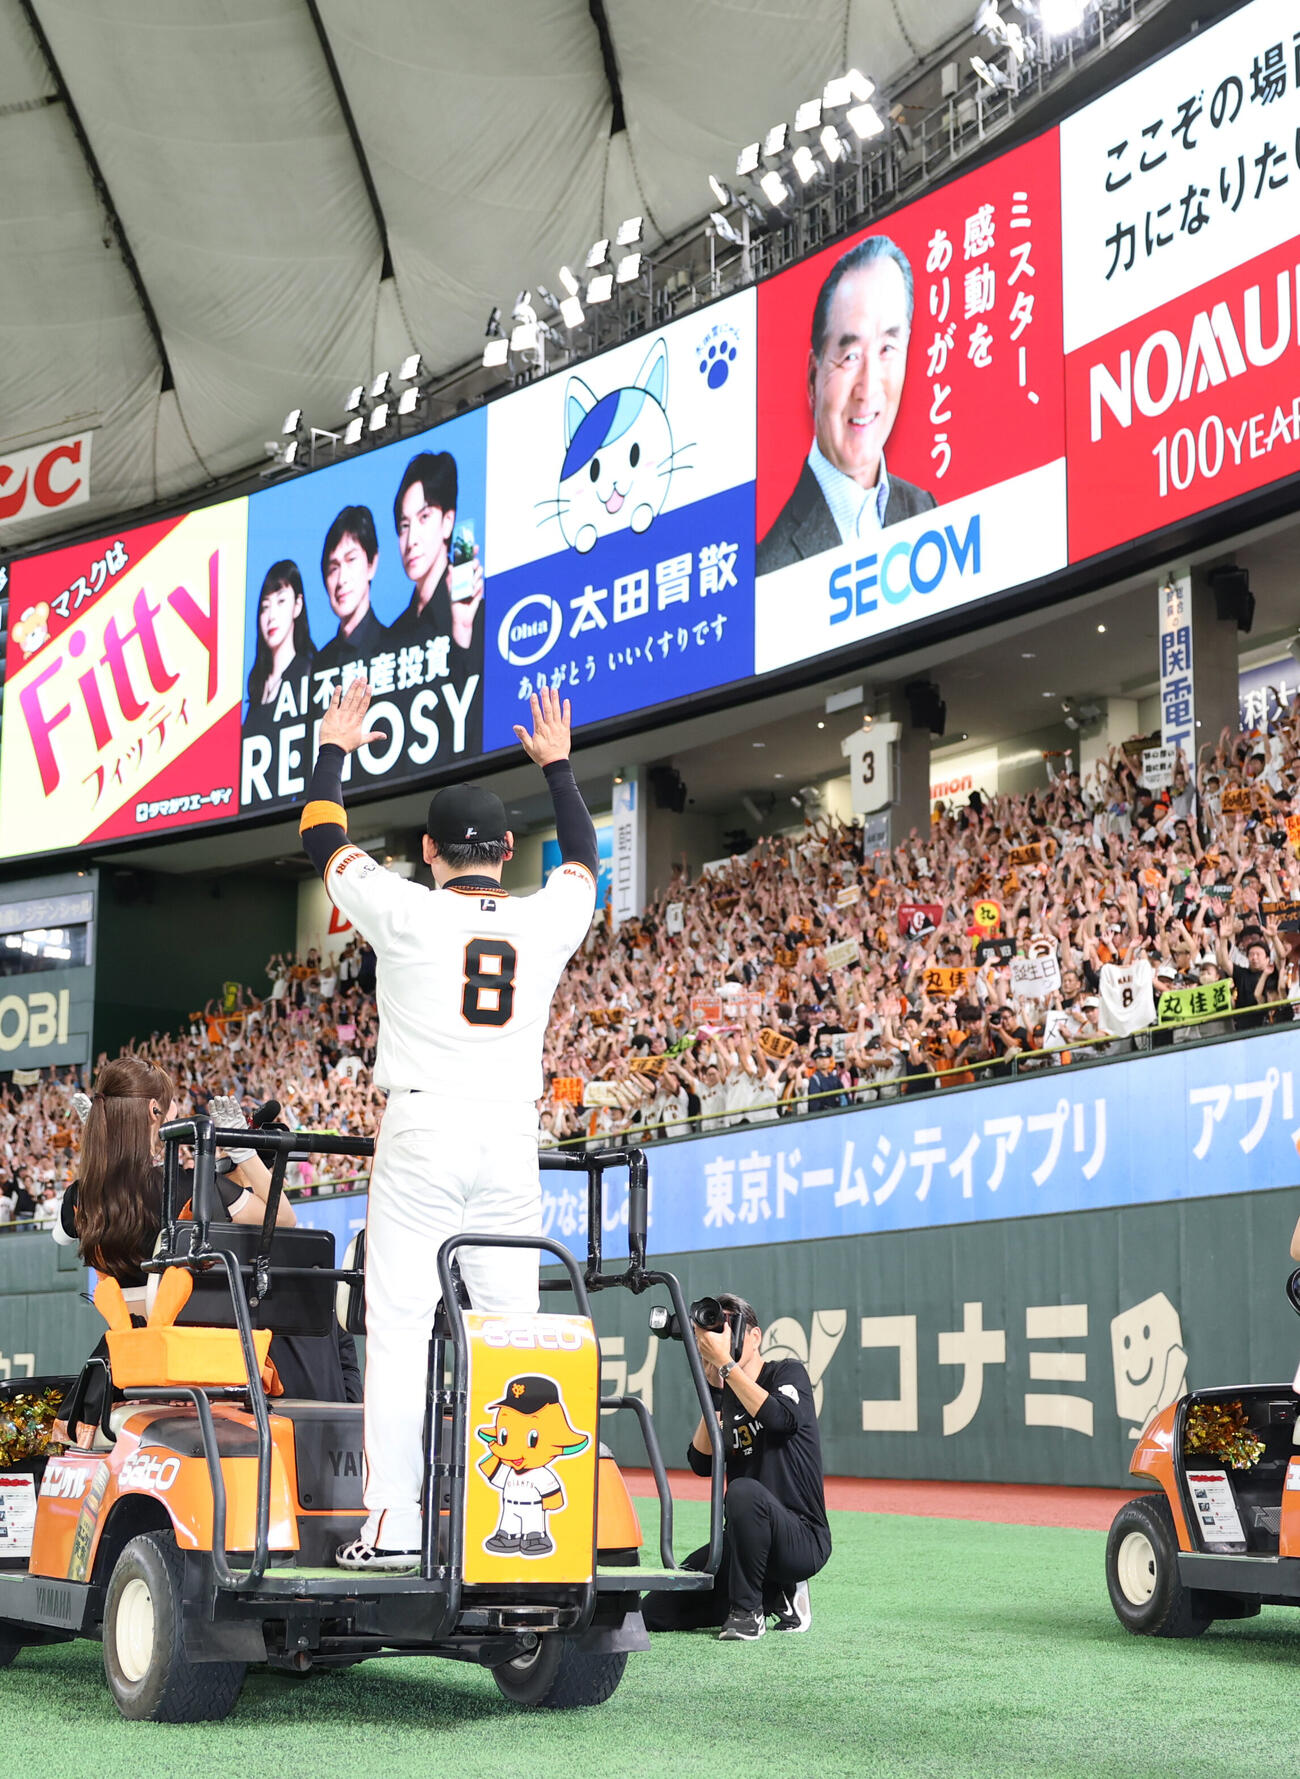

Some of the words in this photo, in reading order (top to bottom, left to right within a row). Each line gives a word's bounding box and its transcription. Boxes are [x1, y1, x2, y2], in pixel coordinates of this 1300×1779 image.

[963, 203, 996, 369] 感動を
[1007, 191, 1040, 405] ミスター、
[925, 228, 955, 479] ありがとう
[1089, 263, 1300, 443] NOMU
[51, 541, 129, 618] マスクは
[569, 541, 739, 639] 太田胃散
[828, 514, 981, 626] SECOM
[19, 547, 220, 798] Fitty
[510, 619, 549, 643] Ohta
[518, 655, 596, 700] ありがとう
[608, 613, 728, 671] いいくすりです
[240, 674, 480, 806] REOSY
[1239, 680, 1300, 733] 科大
[82, 698, 188, 812] フィッティ
[862, 750, 875, 784] 3
[930, 774, 973, 800] mon
[460, 936, 518, 1028] 8
[927, 970, 977, 988] 丸佳
[1012, 959, 1055, 982] 誕生日
[1122, 988, 1133, 1008] 8
[703, 1098, 1106, 1228] 東京ドームシティアプリ
[860, 1302, 1094, 1437] コナミ
[328, 1450, 363, 1477] YA
[36, 1587, 72, 1620] YAMAHA
